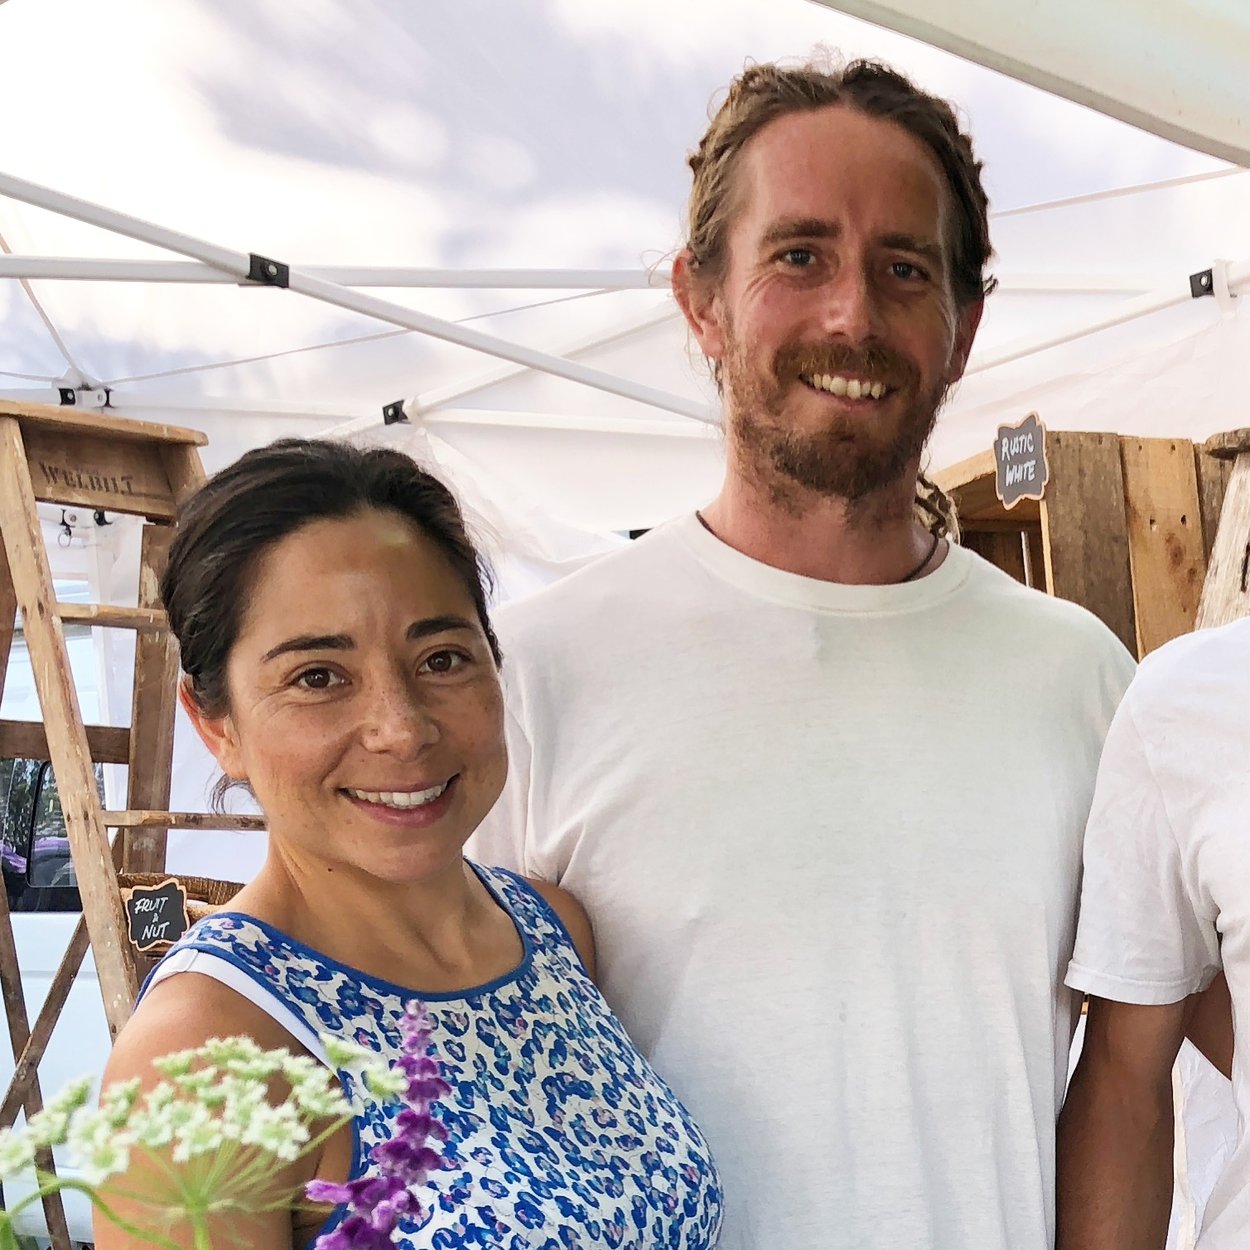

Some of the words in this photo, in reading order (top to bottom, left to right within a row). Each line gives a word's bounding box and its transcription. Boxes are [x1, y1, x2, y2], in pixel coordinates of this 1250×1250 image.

[1005, 460, 1036, 487] WHITE
[134, 897, 169, 914] FRUIT
[141, 921, 170, 940] NUT
